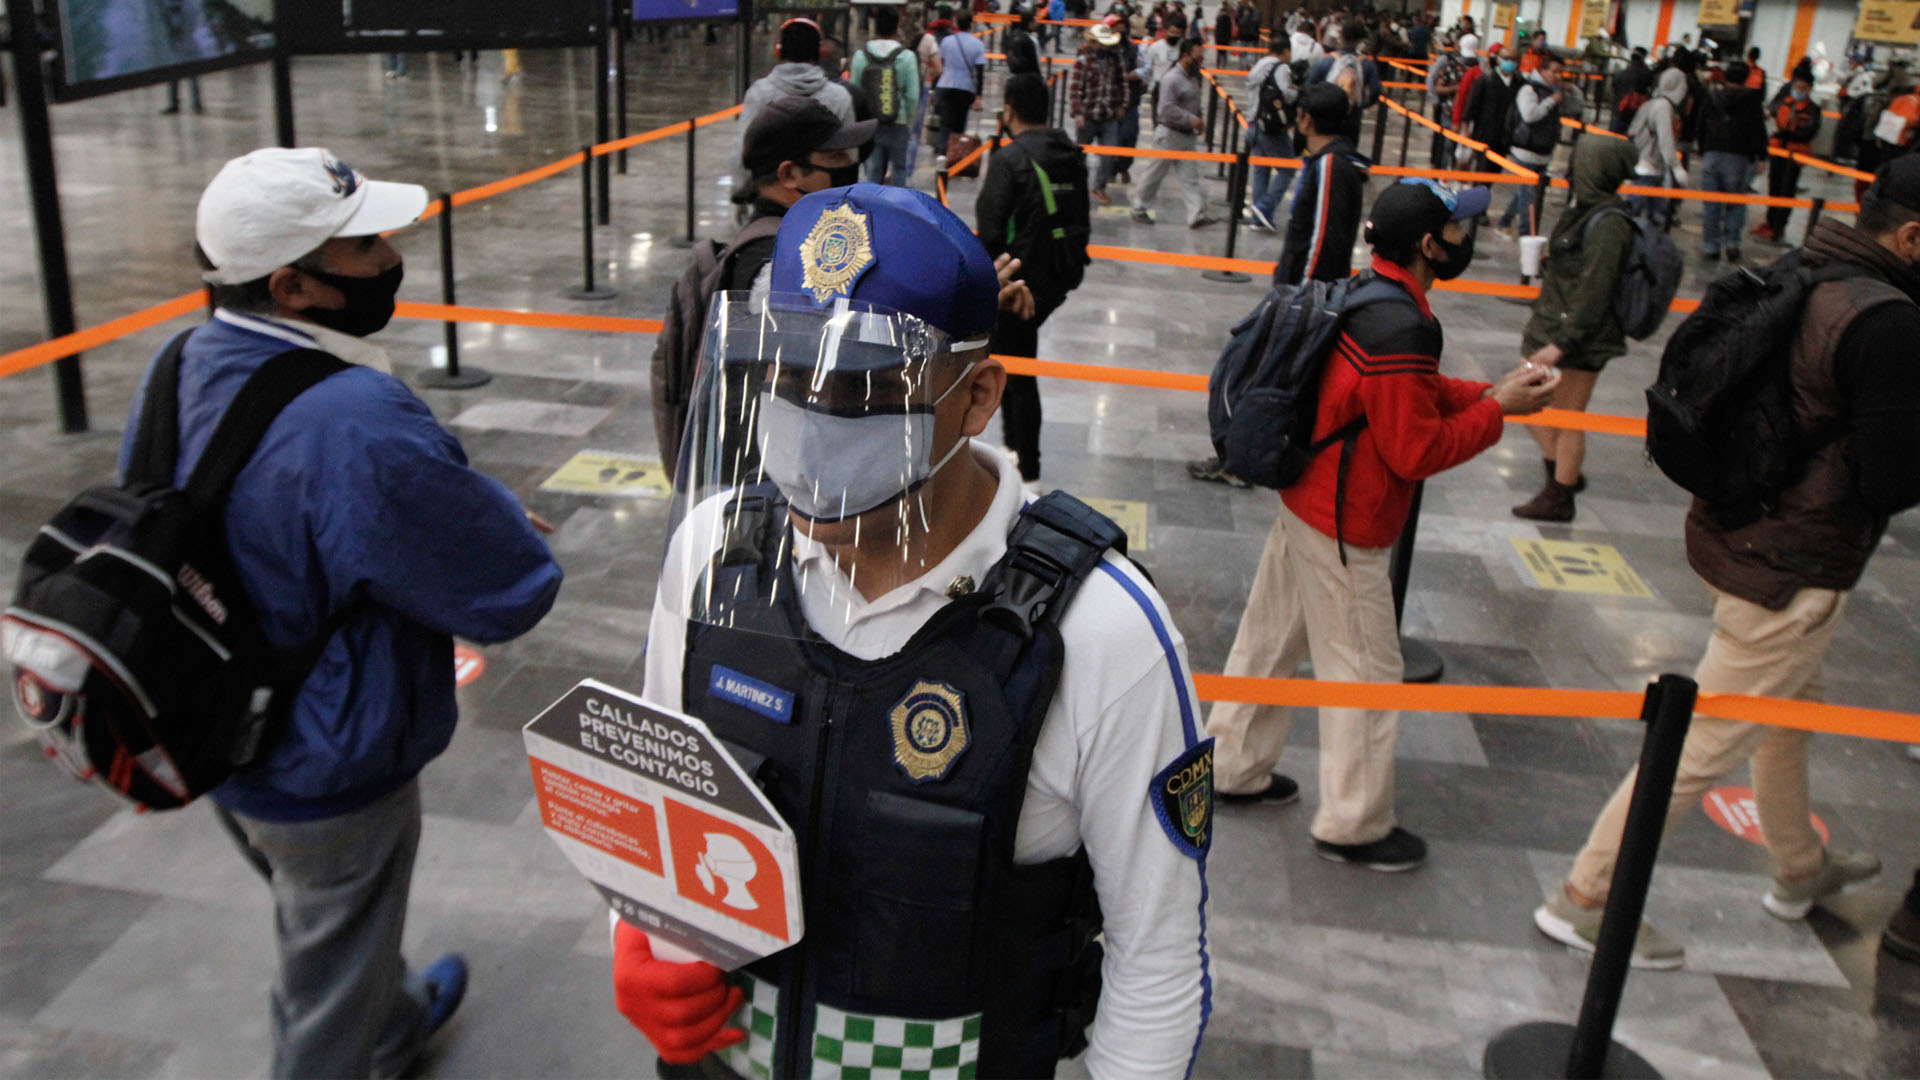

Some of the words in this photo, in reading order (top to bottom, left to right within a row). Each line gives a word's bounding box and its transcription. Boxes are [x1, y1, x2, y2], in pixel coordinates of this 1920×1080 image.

[880, 69, 893, 115] adidas
[178, 560, 228, 625] Wilson
[725, 678, 774, 708] MARTINEZ
[579, 712, 714, 777] PREVENIMOS
[586, 698, 700, 753] CALLADOS
[580, 731, 606, 754] EL
[609, 743, 719, 797] CONTAGIO
[1167, 748, 1213, 795] CDMX
